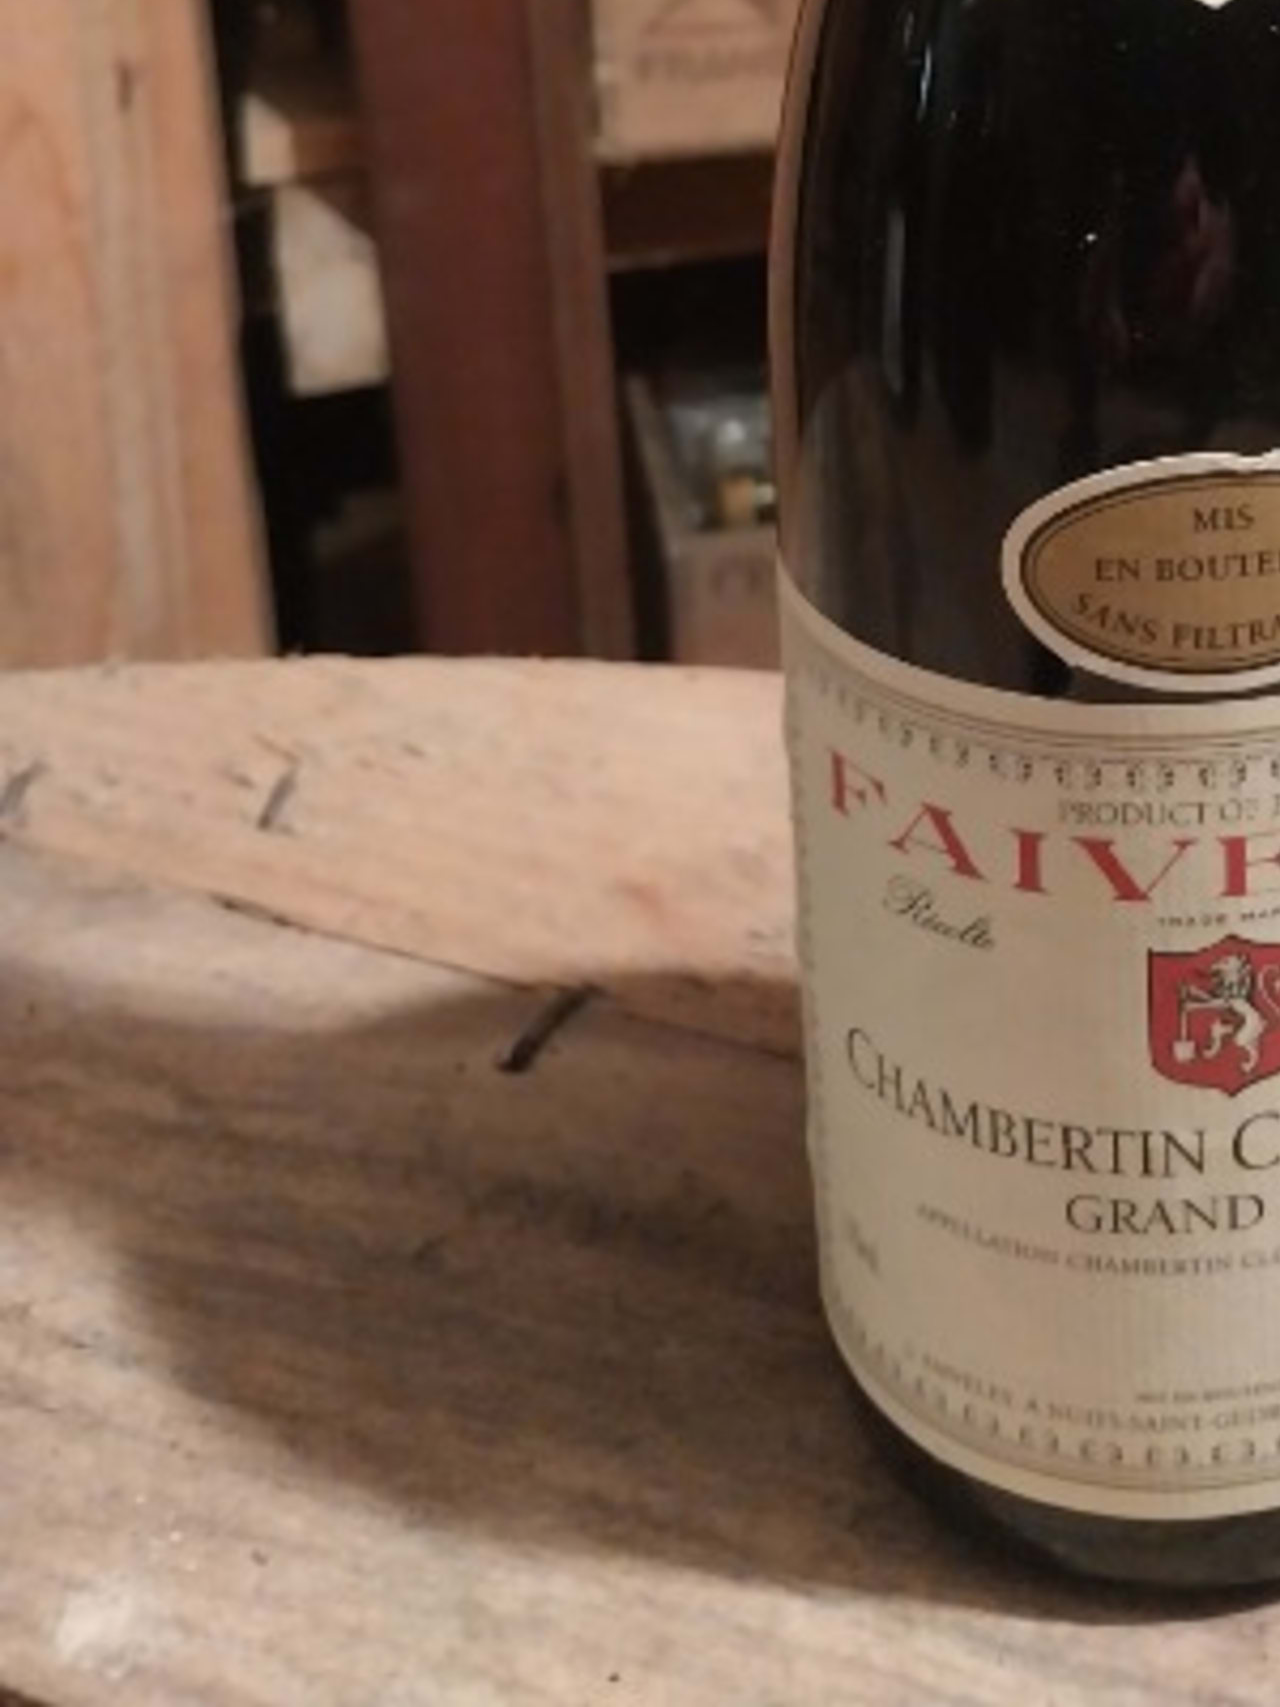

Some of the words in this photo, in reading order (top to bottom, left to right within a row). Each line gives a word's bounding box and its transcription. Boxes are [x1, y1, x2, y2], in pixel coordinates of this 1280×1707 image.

[1193, 504, 1256, 534] MIS
[1094, 557, 1141, 583] EN
[1071, 592, 1158, 646] SANS
[1058, 800, 1210, 826] PRODUCT
[846, 1026, 1208, 1179] CHAMBERTIN
[1064, 1193, 1265, 1237] GRAND
[1065, 1251, 1232, 1276] CHAMBERTIN
